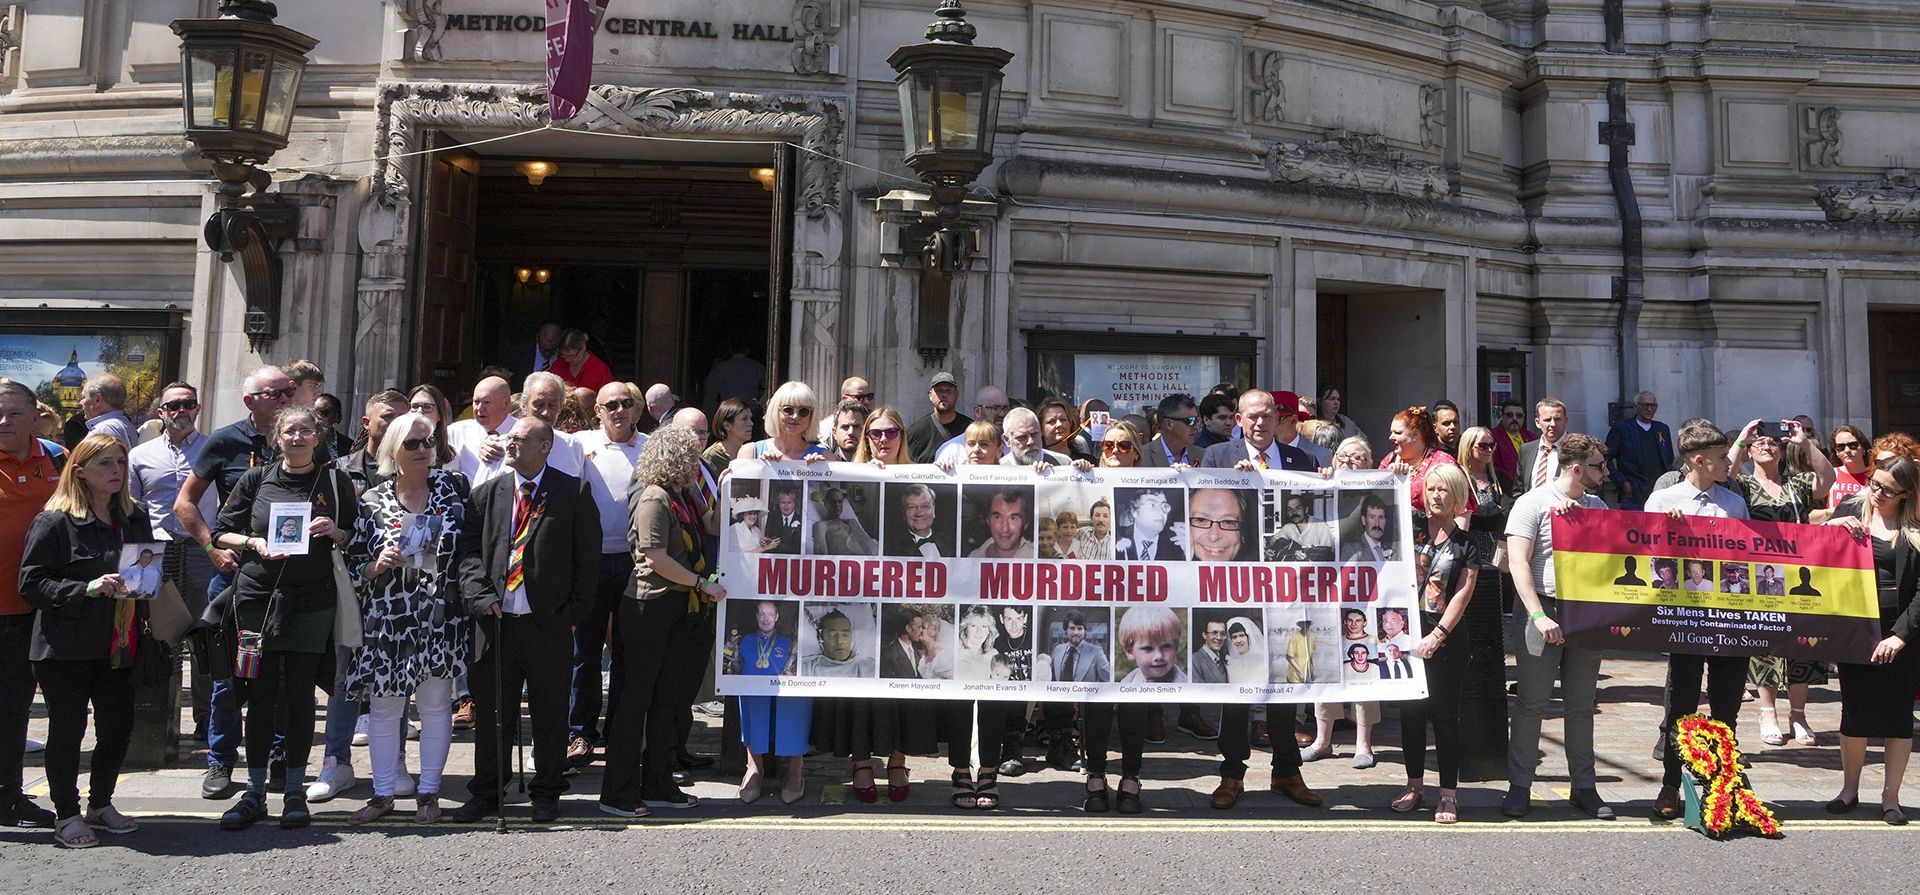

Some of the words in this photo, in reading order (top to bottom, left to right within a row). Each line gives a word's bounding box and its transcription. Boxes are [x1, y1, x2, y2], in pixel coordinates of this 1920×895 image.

[448, 14, 546, 32] METHOD
[605, 17, 717, 39] CENTRAL
[732, 23, 794, 43] HALL
[1120, 372, 1179, 380] METHODIST
[1112, 382, 1158, 390] CENTRAL
[1162, 383, 1188, 391] HALL
[1270, 479, 1287, 487] Barry
[1626, 528, 1660, 545] Our
[1667, 530, 1747, 550] Families
[1752, 537, 1797, 554] PAIN
[758, 557, 947, 598] MURDERED
[980, 562, 1168, 602] MURDERED
[1199, 565, 1378, 603] MURDERED
[1657, 606, 1674, 616] Six
[1677, 607, 1704, 617] Mens
[1708, 608, 1741, 620] Lives
[1744, 610, 1786, 622] TAKEN
[1652, 617, 1688, 627] Destroyed
[1690, 619, 1698, 627] by
[1700, 620, 1757, 630] Contaminated
[1759, 623, 1784, 632] Factor
[1669, 631, 1685, 643] All
[1687, 632, 1714, 645] Gone
[1716, 633, 1737, 646] Too
[1740, 635, 1769, 648] Soon
[911, 682, 940, 691] Hayward
[1047, 685, 1070, 693] Harvey
[1072, 685, 1099, 694] Carbery
